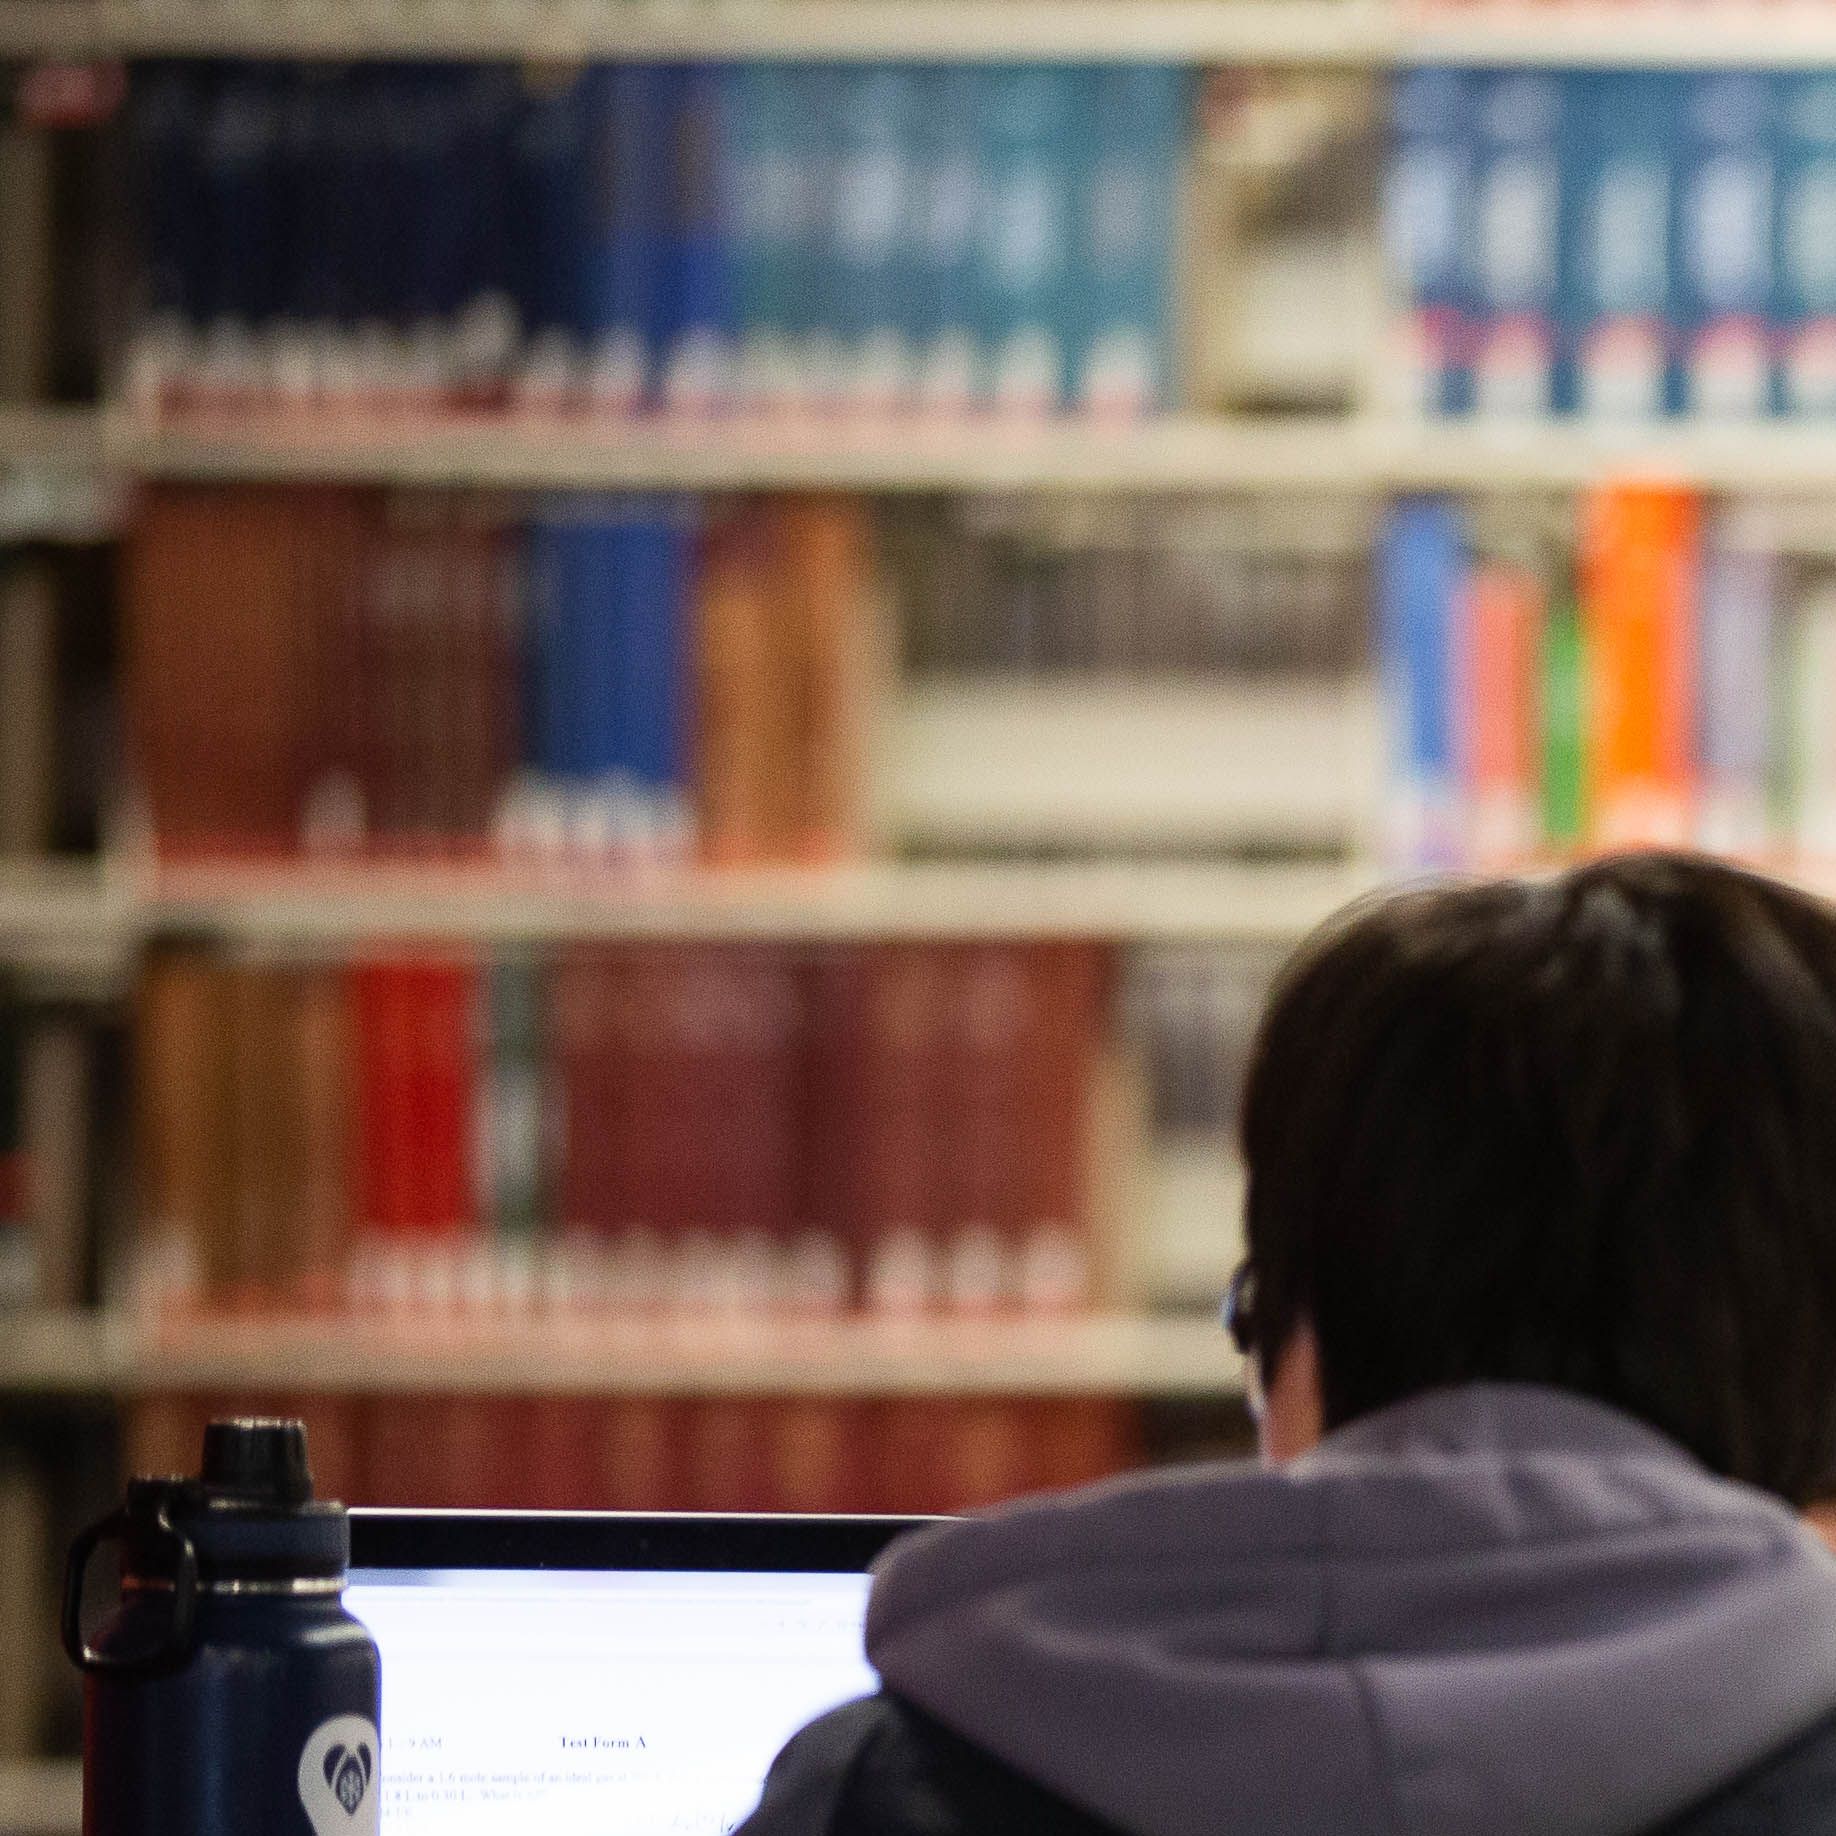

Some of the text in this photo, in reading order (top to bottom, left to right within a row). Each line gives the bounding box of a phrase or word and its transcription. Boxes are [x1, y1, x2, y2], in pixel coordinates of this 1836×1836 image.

[419, 1736, 443, 1749] AM
[560, 1736, 647, 1749] Test Form A
[491, 1772, 529, 1785] sample
